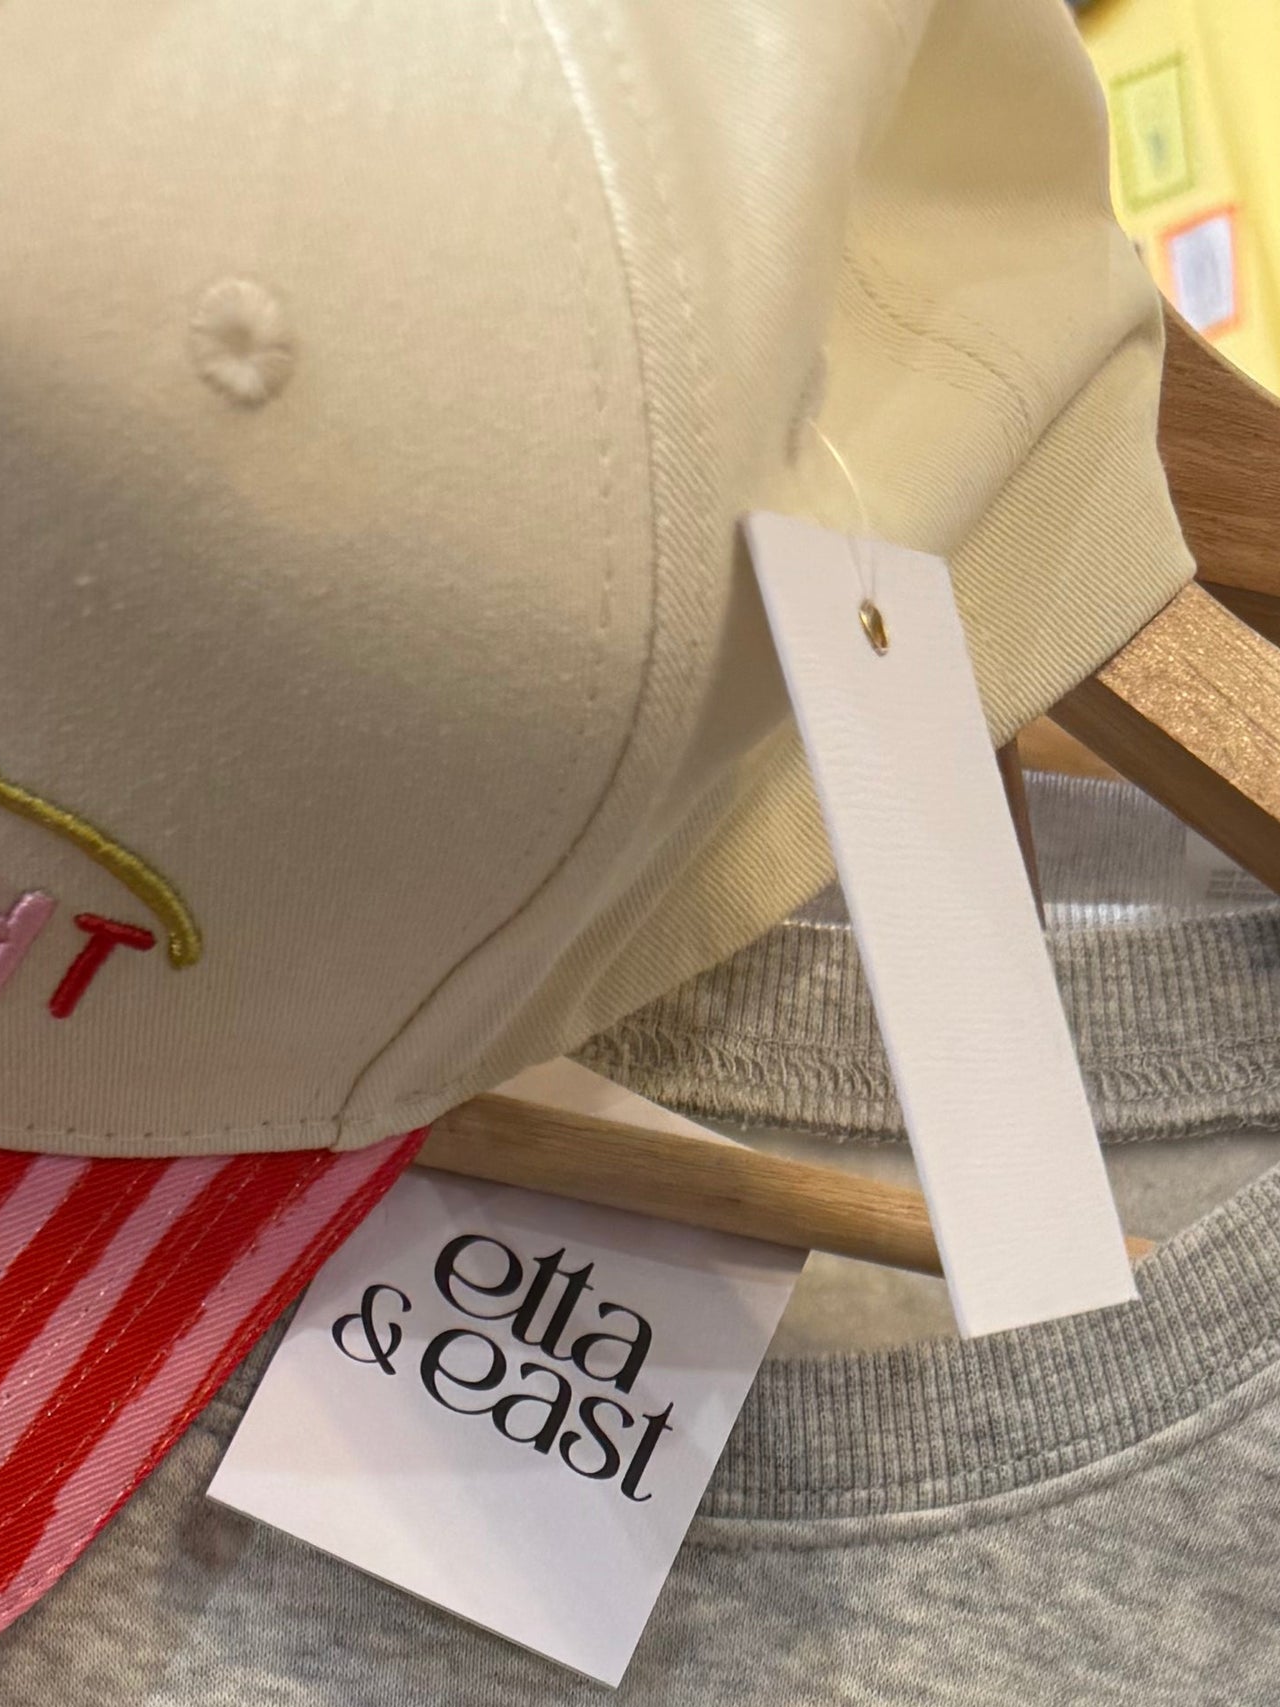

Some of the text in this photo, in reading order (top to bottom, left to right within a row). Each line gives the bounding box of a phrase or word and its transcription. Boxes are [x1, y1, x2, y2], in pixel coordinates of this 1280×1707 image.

[331, 1283, 675, 1503] & east
[433, 1233, 654, 1395] etta
